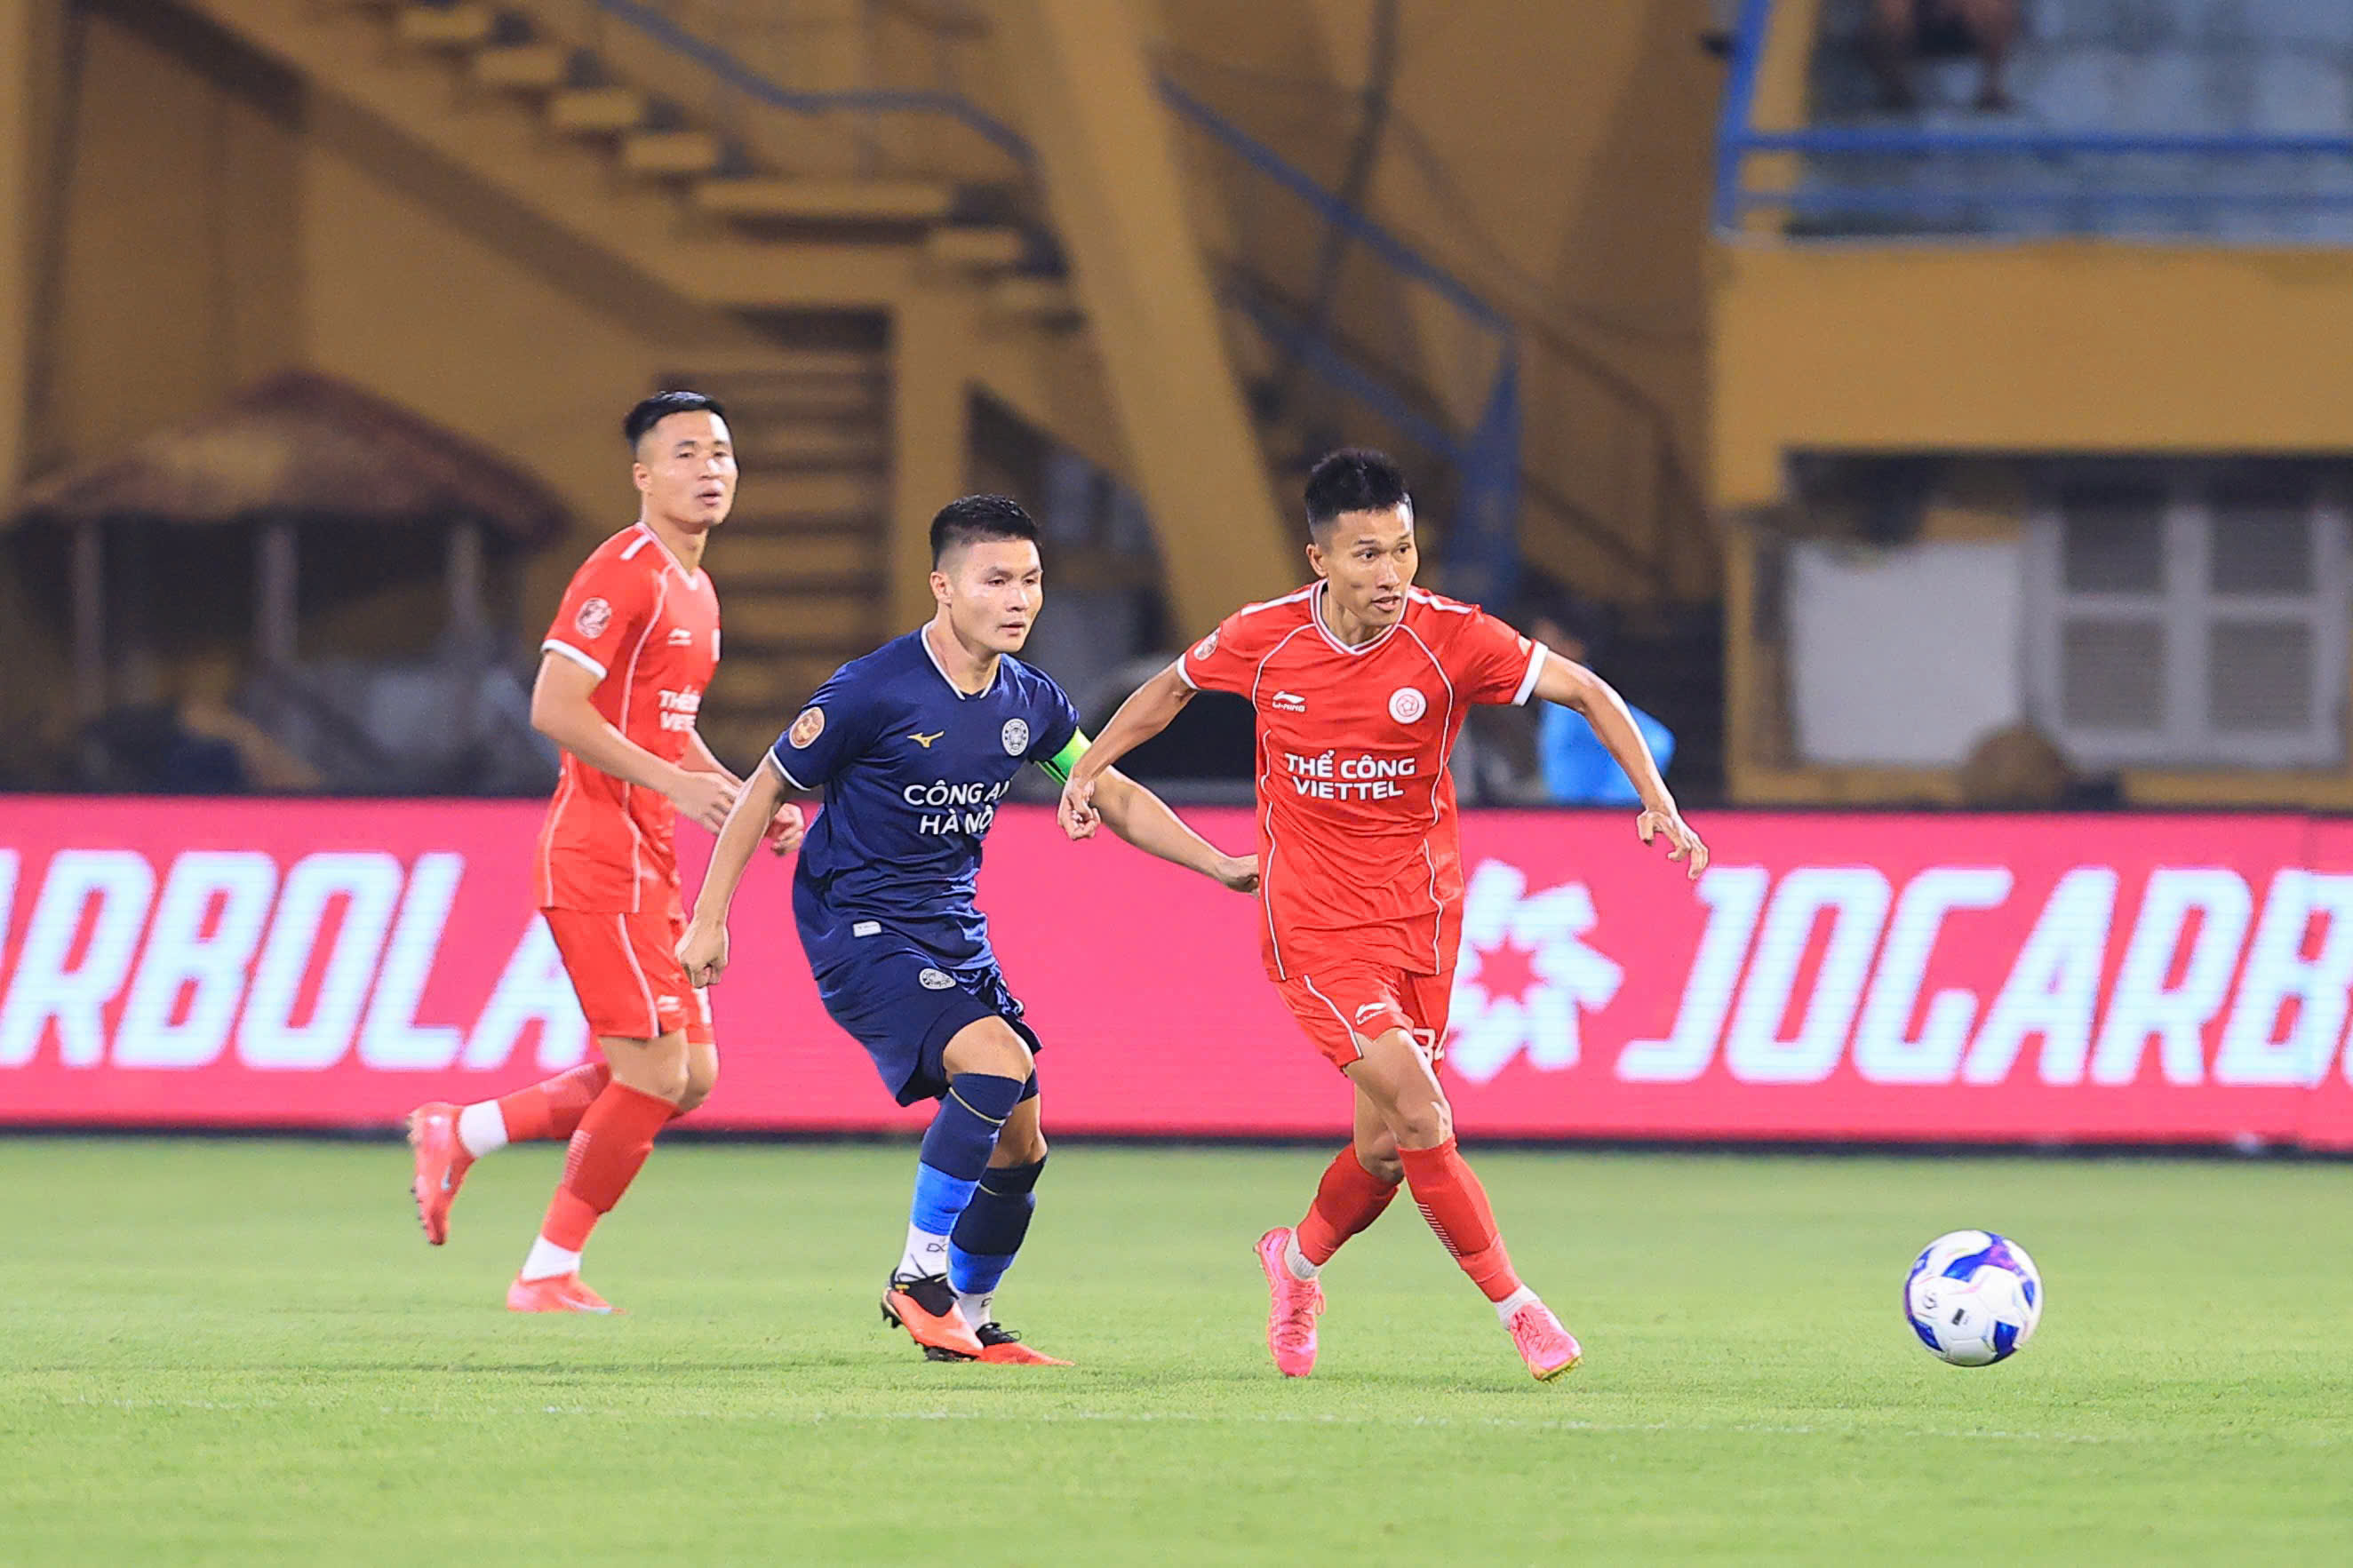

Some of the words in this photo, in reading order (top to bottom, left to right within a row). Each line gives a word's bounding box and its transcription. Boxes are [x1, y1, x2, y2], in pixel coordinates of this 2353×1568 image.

[1284, 749, 1335, 778] THỂ
[1340, 754, 1416, 779] CÔNG
[904, 779, 985, 806] CÔNG
[1292, 776, 1404, 800] VIETTEL
[919, 808, 960, 835] HÀ
[964, 804, 994, 835] NỘ
[0, 848, 590, 1071] RBOLA
[1612, 864, 2353, 1089] JOGARB
